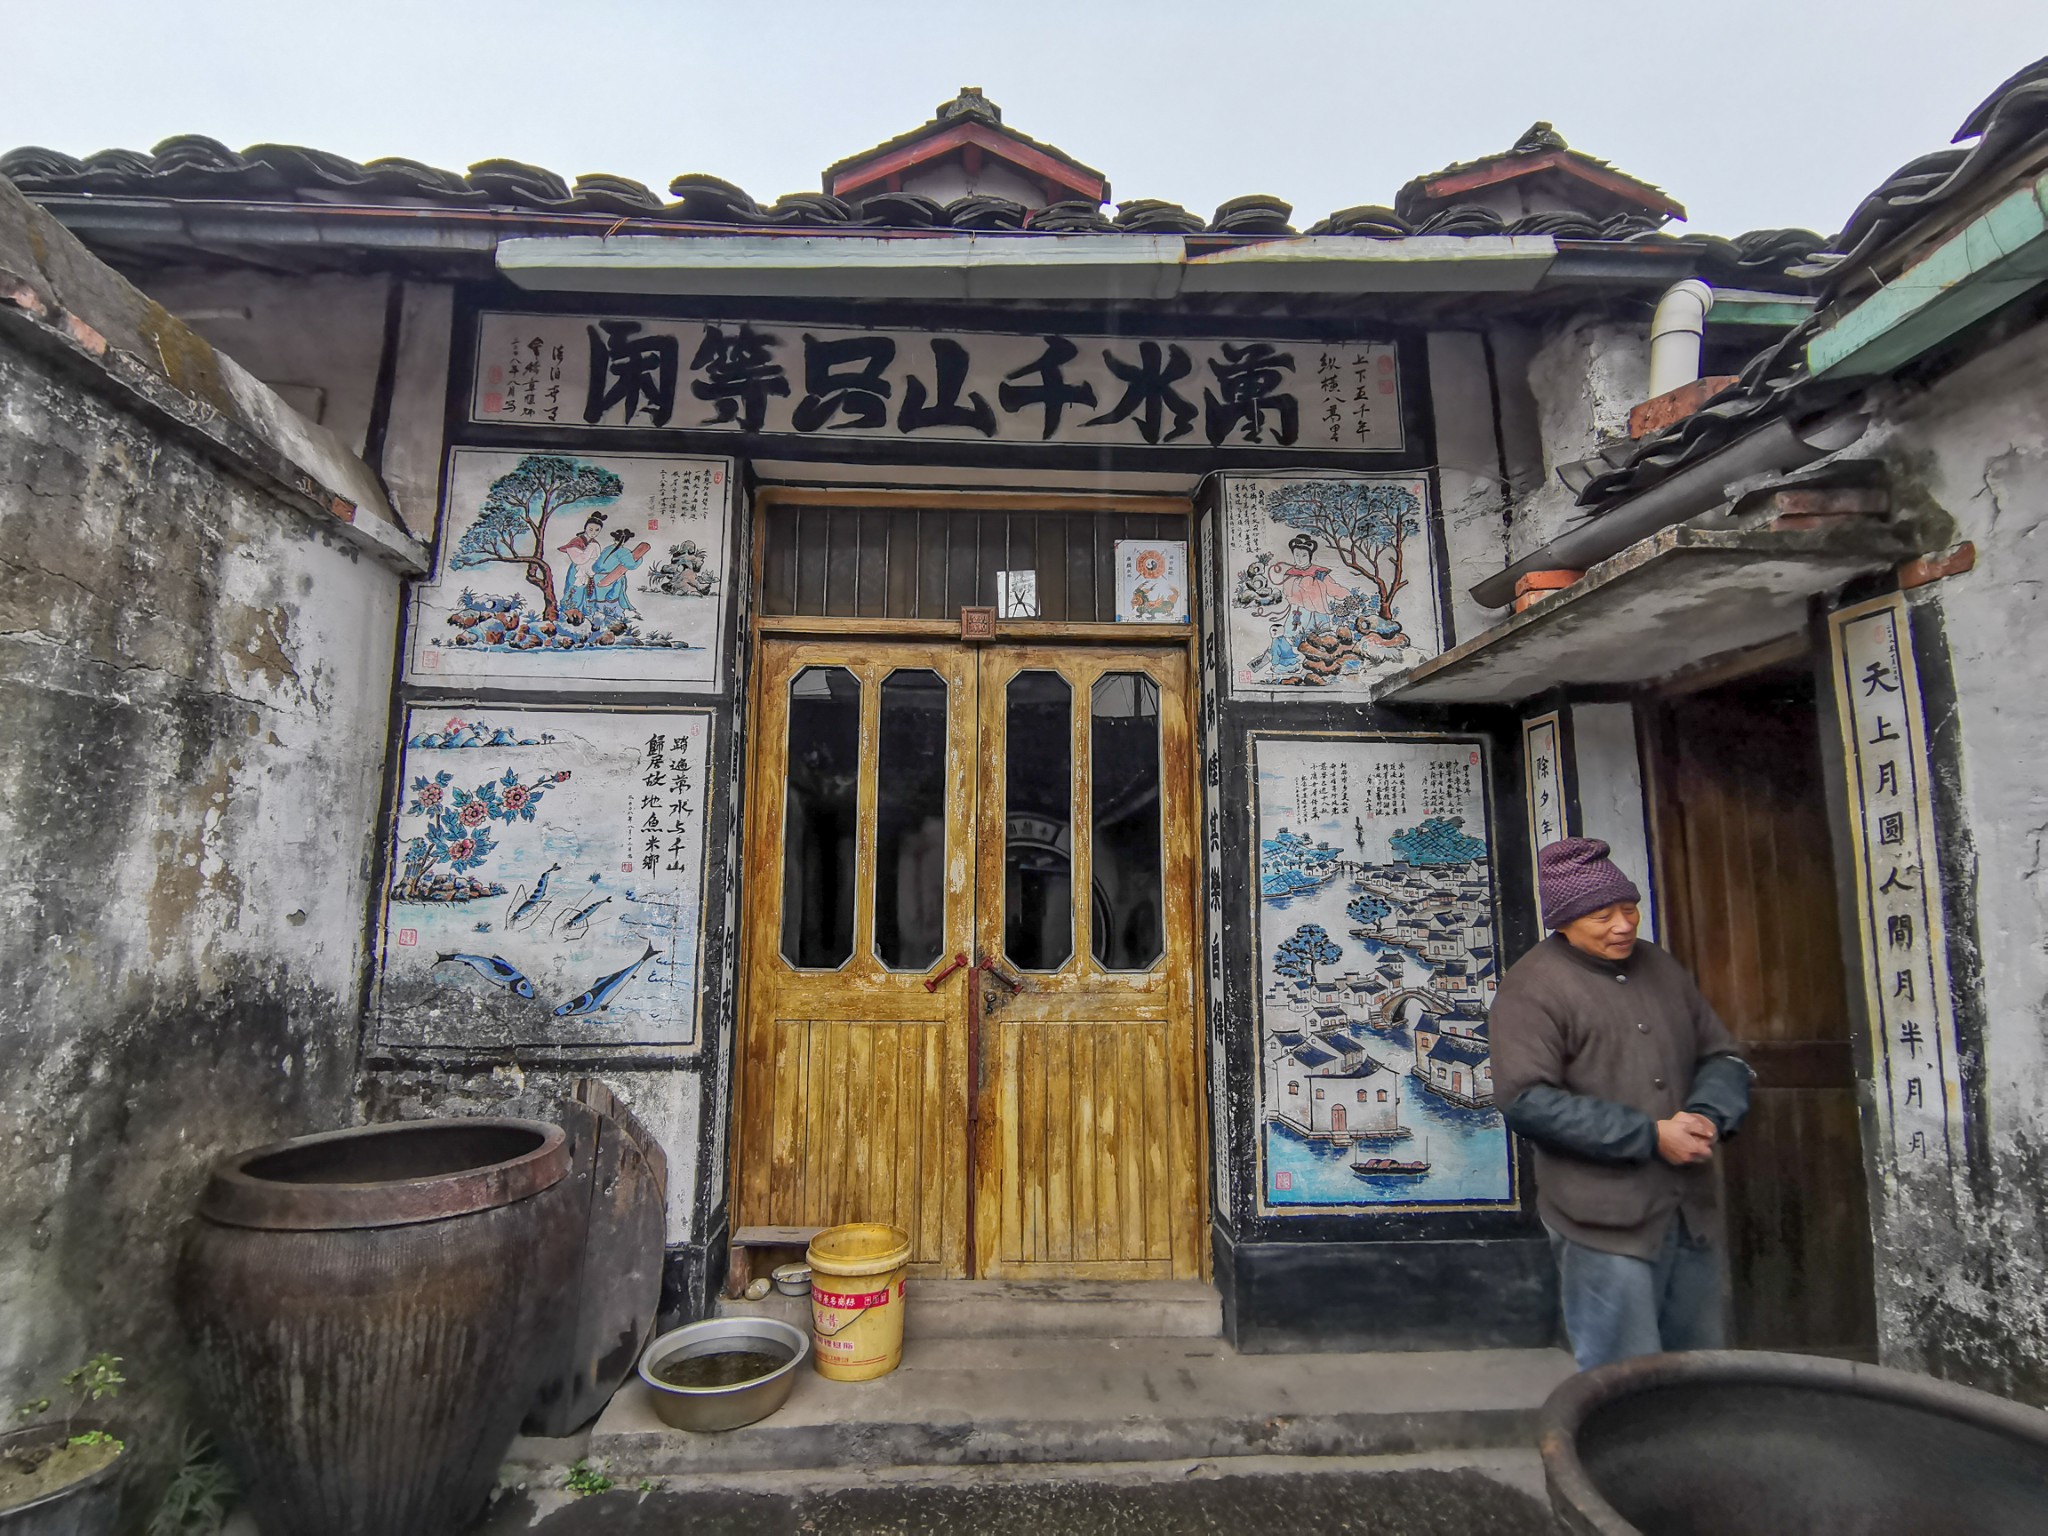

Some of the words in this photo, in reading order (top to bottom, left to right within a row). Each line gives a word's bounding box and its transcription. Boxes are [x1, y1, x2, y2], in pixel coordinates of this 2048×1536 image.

[1352, 354, 1371, 443] 上下五千年
[1536, 755, 1553, 842] 除夕年
